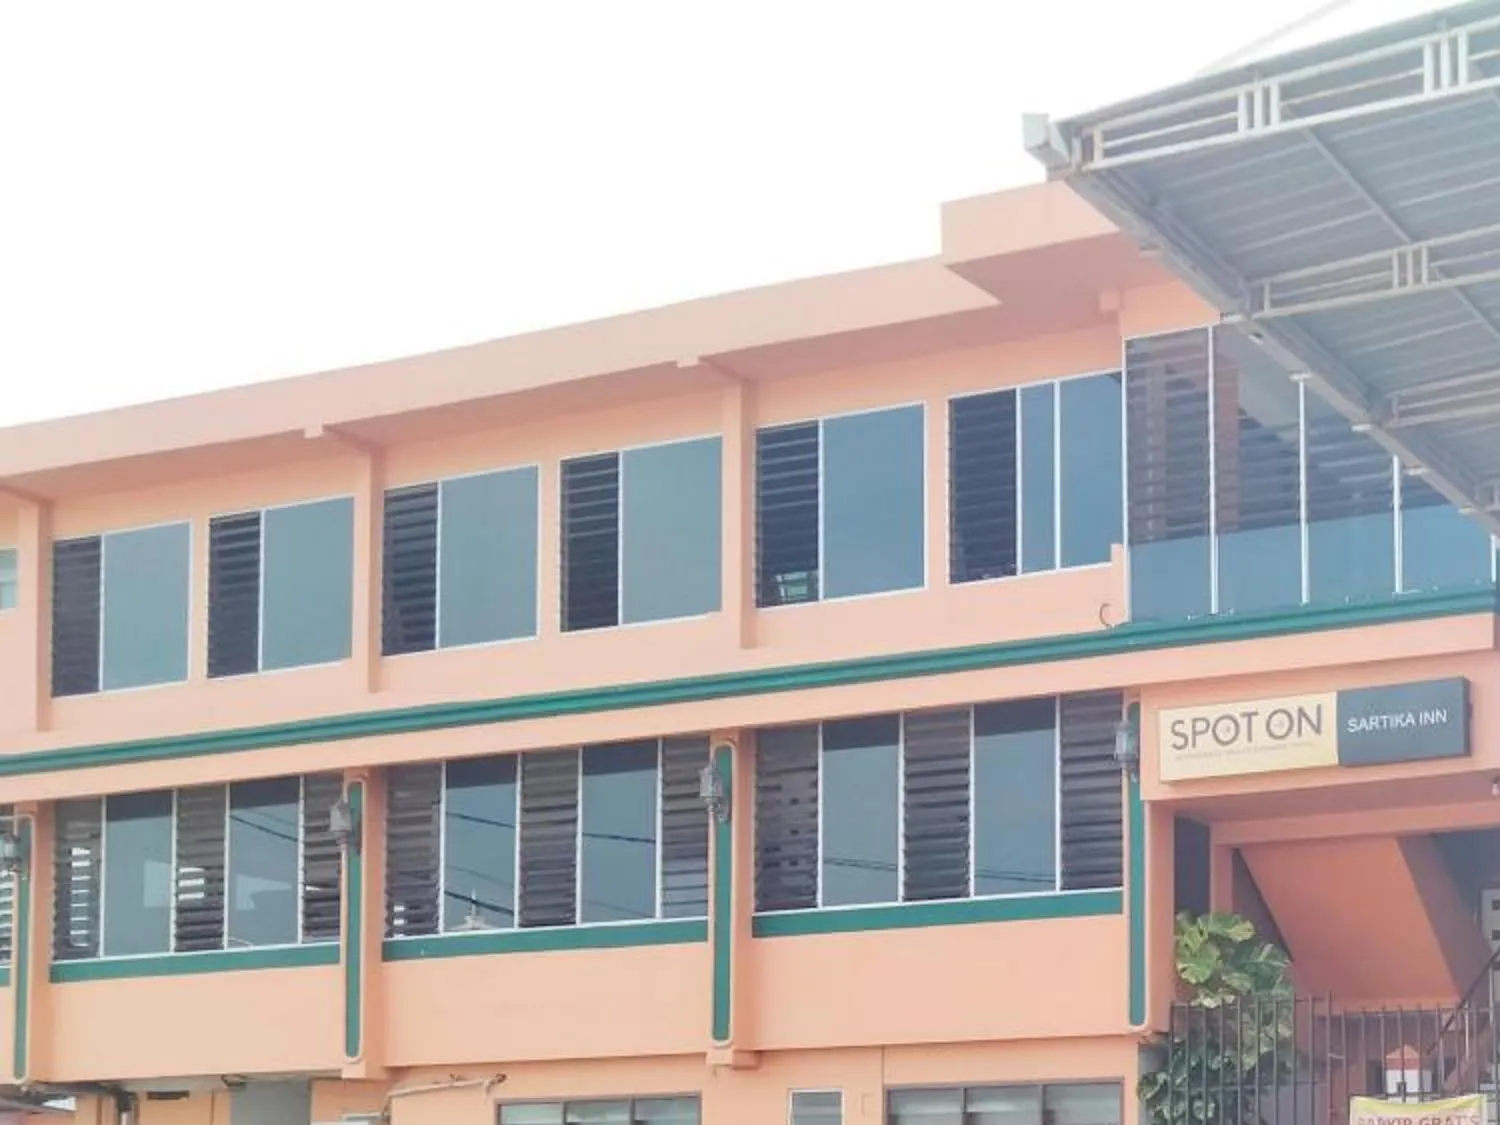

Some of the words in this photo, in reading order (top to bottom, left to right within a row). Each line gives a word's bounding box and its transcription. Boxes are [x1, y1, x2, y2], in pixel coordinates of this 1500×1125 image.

[1170, 709, 1258, 750] SPOT
[1265, 703, 1322, 740] ON
[1346, 711, 1415, 733] SARTIKA
[1419, 707, 1448, 726] INN
